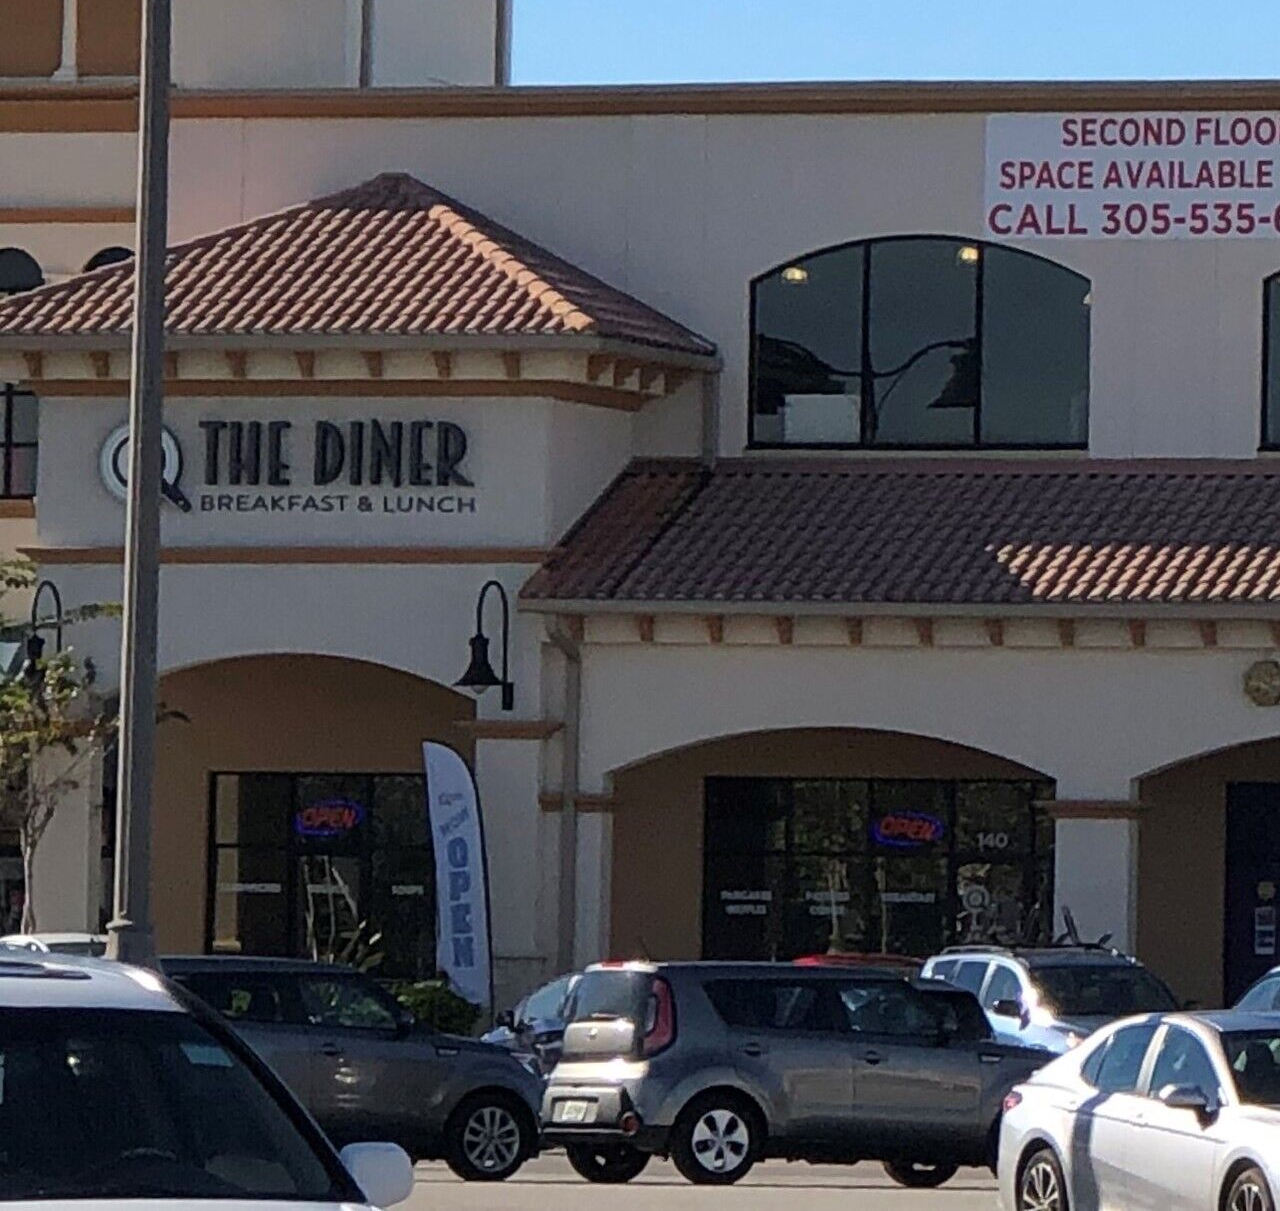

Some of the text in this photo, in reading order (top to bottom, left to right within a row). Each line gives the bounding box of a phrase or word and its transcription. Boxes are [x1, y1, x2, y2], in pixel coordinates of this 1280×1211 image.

[1061, 118, 1186, 147] SECOND
[1000, 161, 1094, 189] SPACE
[1103, 160, 1273, 189] AVAILABLE
[988, 204, 1088, 235] CALL
[199, 418, 475, 488] THE DINER
[200, 495, 477, 514] BREAKFAST & LUNCH
[302, 806, 357, 829] OPEN
[879, 815, 937, 841] OPEN
[976, 832, 1008, 850] 140
[447, 838, 475, 968] OPEN
